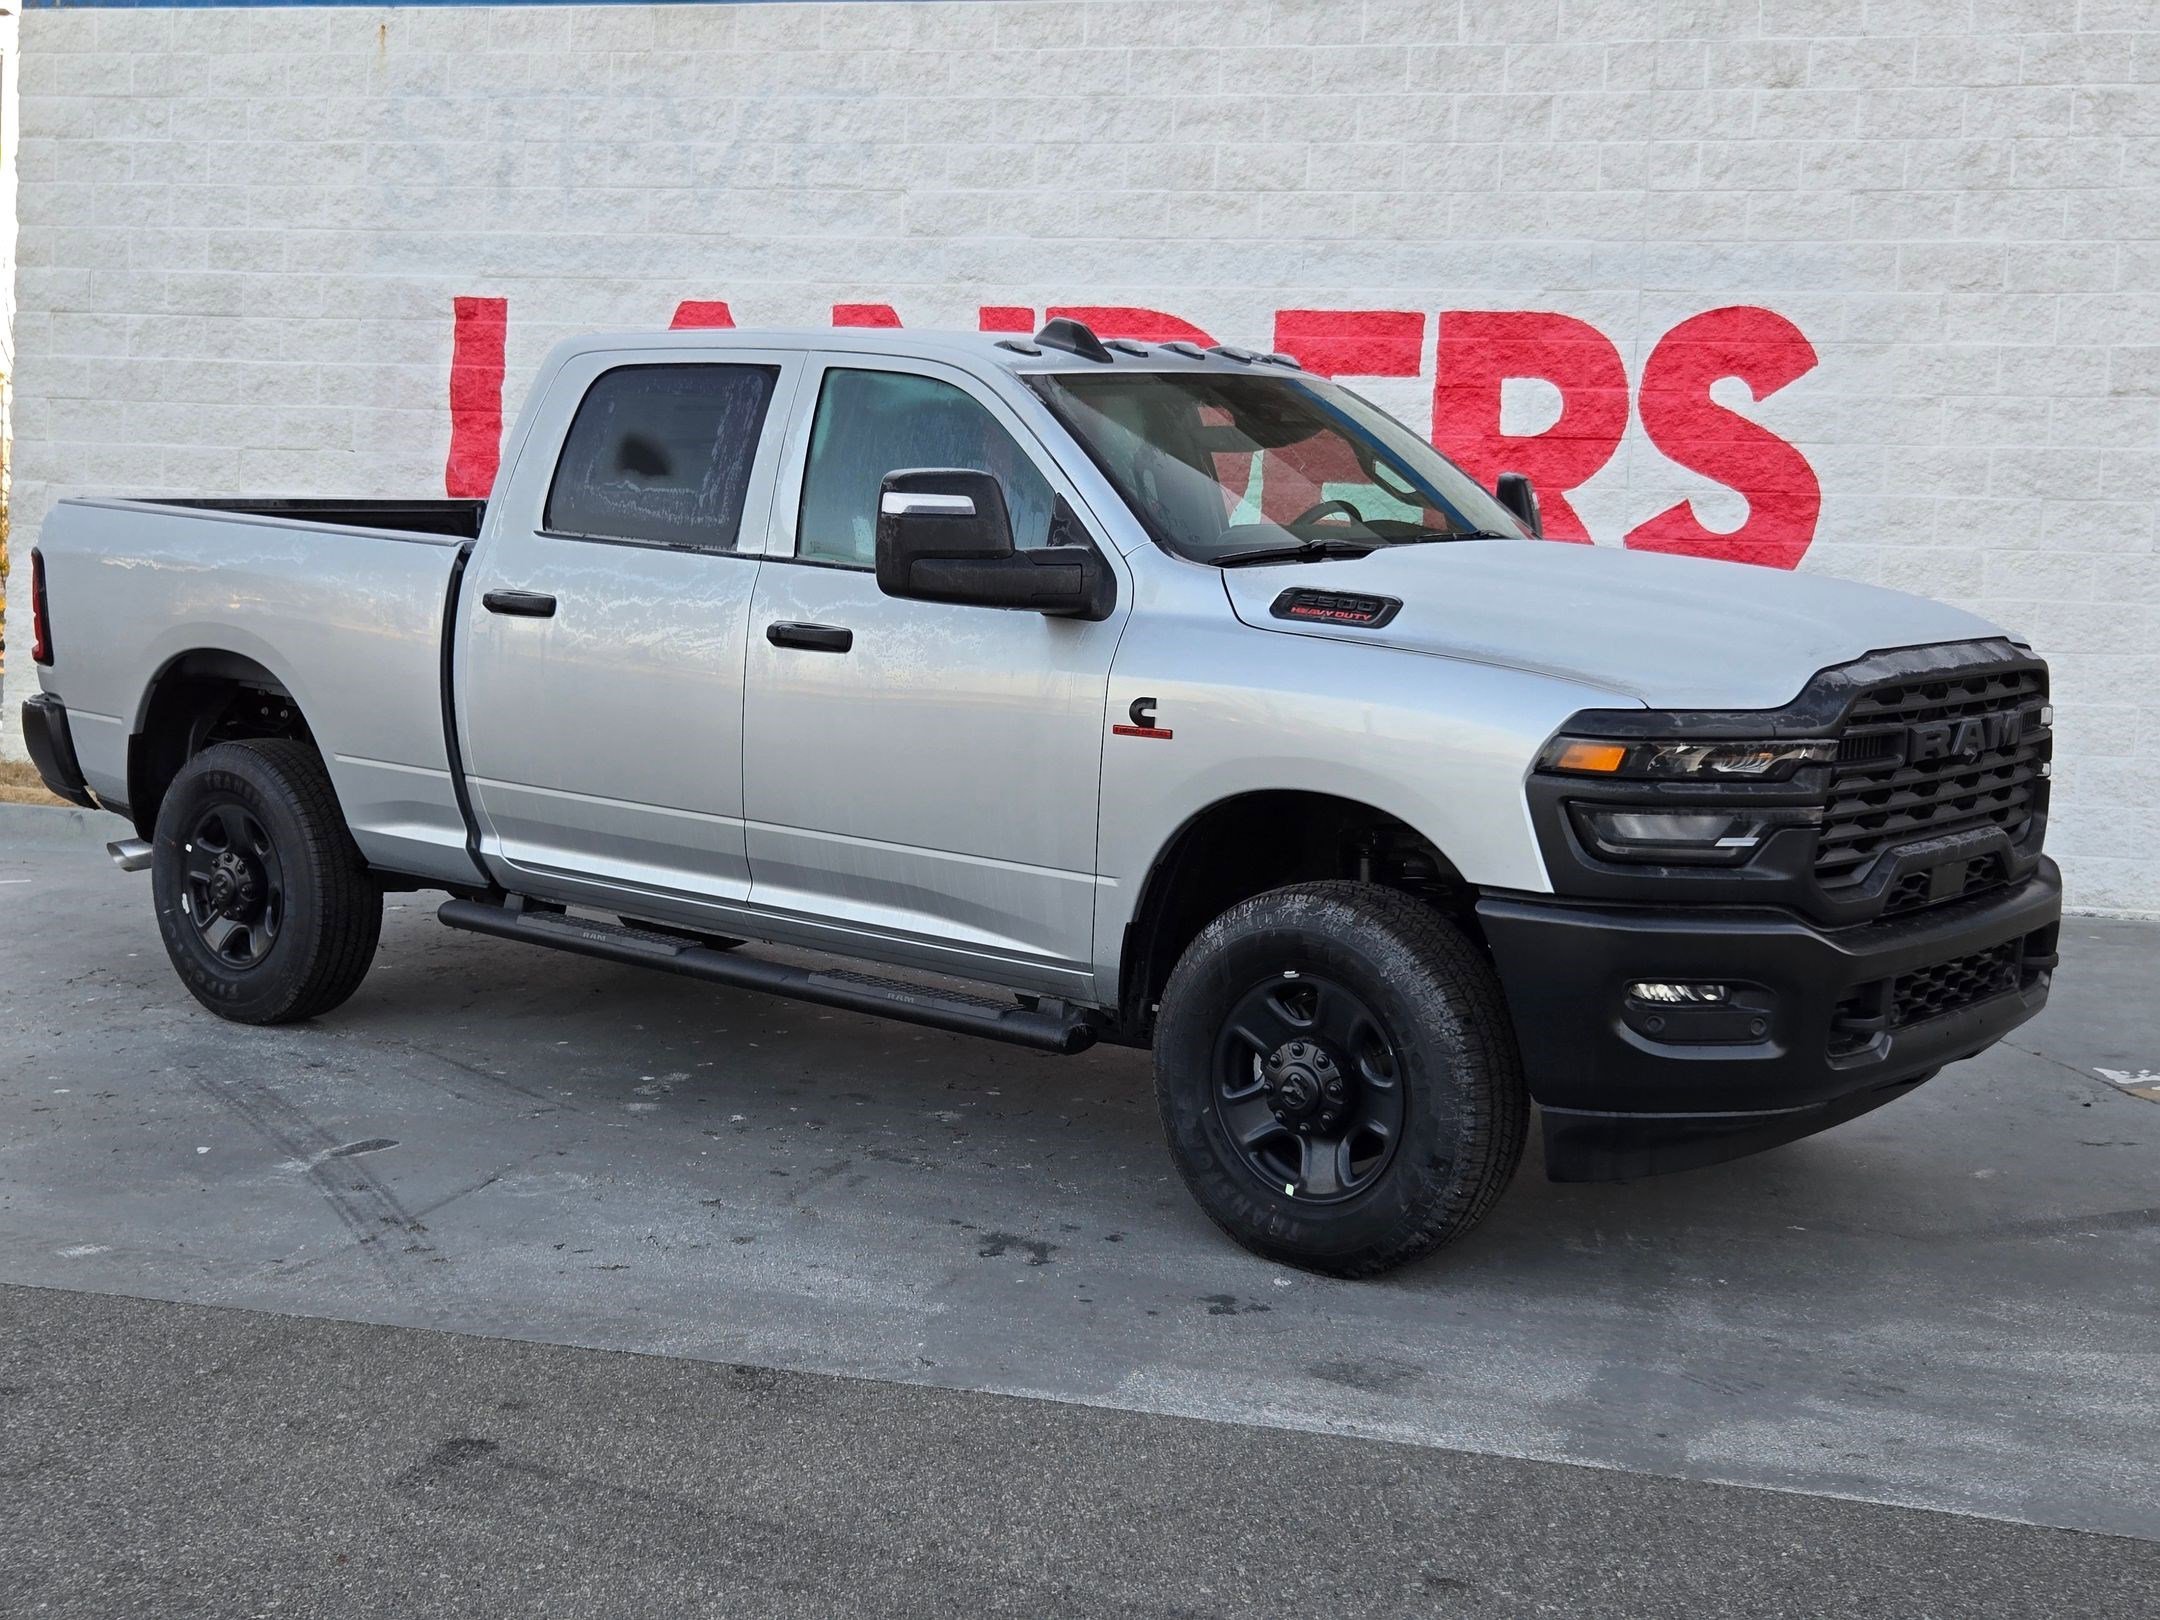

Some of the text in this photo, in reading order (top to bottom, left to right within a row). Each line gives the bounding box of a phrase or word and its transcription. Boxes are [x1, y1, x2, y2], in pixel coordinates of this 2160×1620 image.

[1297, 592, 1377, 612] 2500
[1290, 606, 1373, 621] HEAVY DUTY
[1907, 709, 2021, 763] RAM
[582, 931, 607, 941] RAM
[887, 992, 914, 1004] RAM
